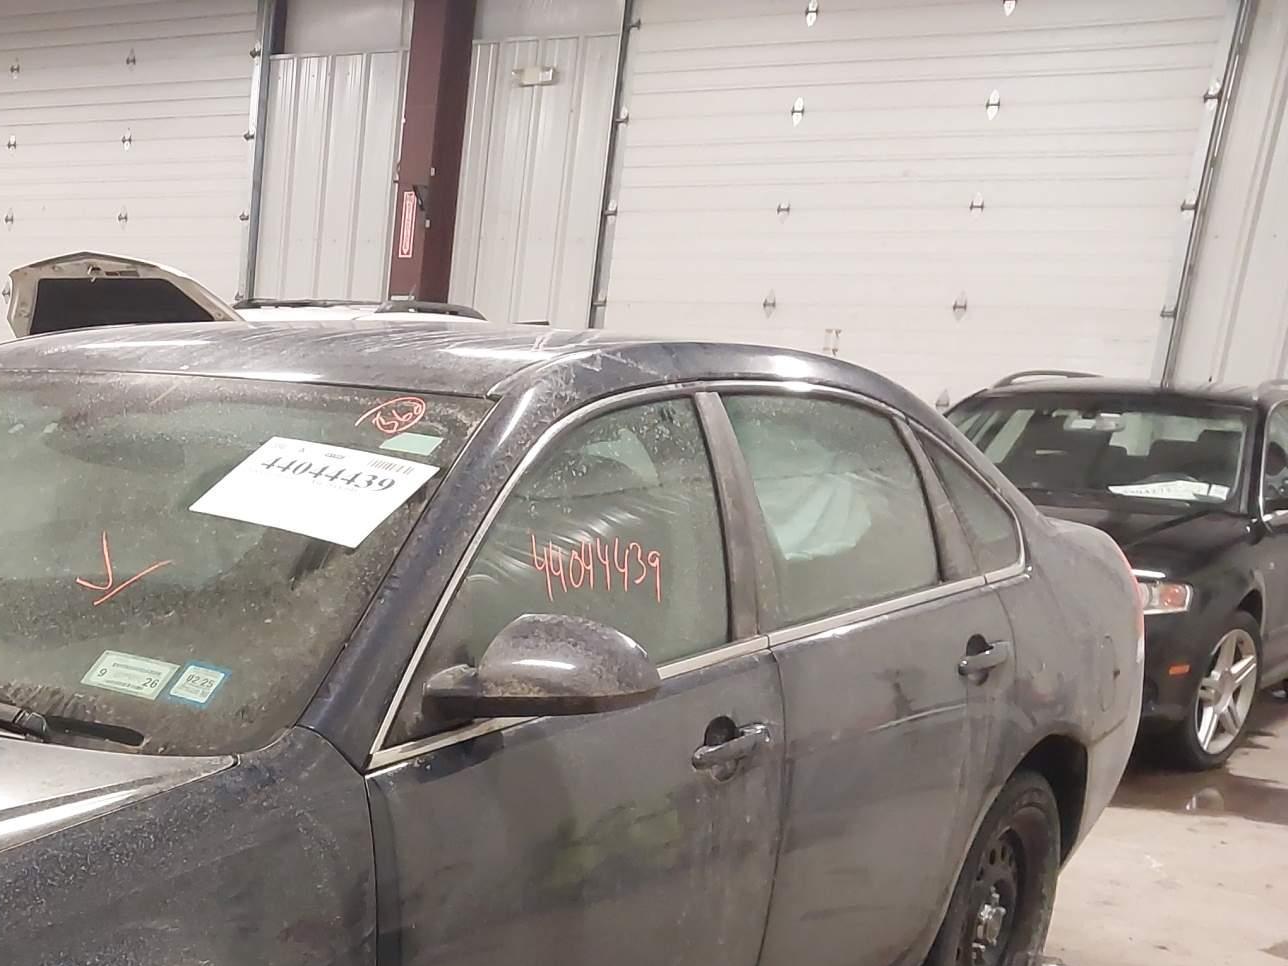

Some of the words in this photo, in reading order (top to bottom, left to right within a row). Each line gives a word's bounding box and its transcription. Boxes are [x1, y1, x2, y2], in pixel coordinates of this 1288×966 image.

[261, 456, 396, 492] 44044439
[531, 534, 661, 603] 44044439
[97, 667, 108, 678] 9
[142, 677, 160, 689] 26
